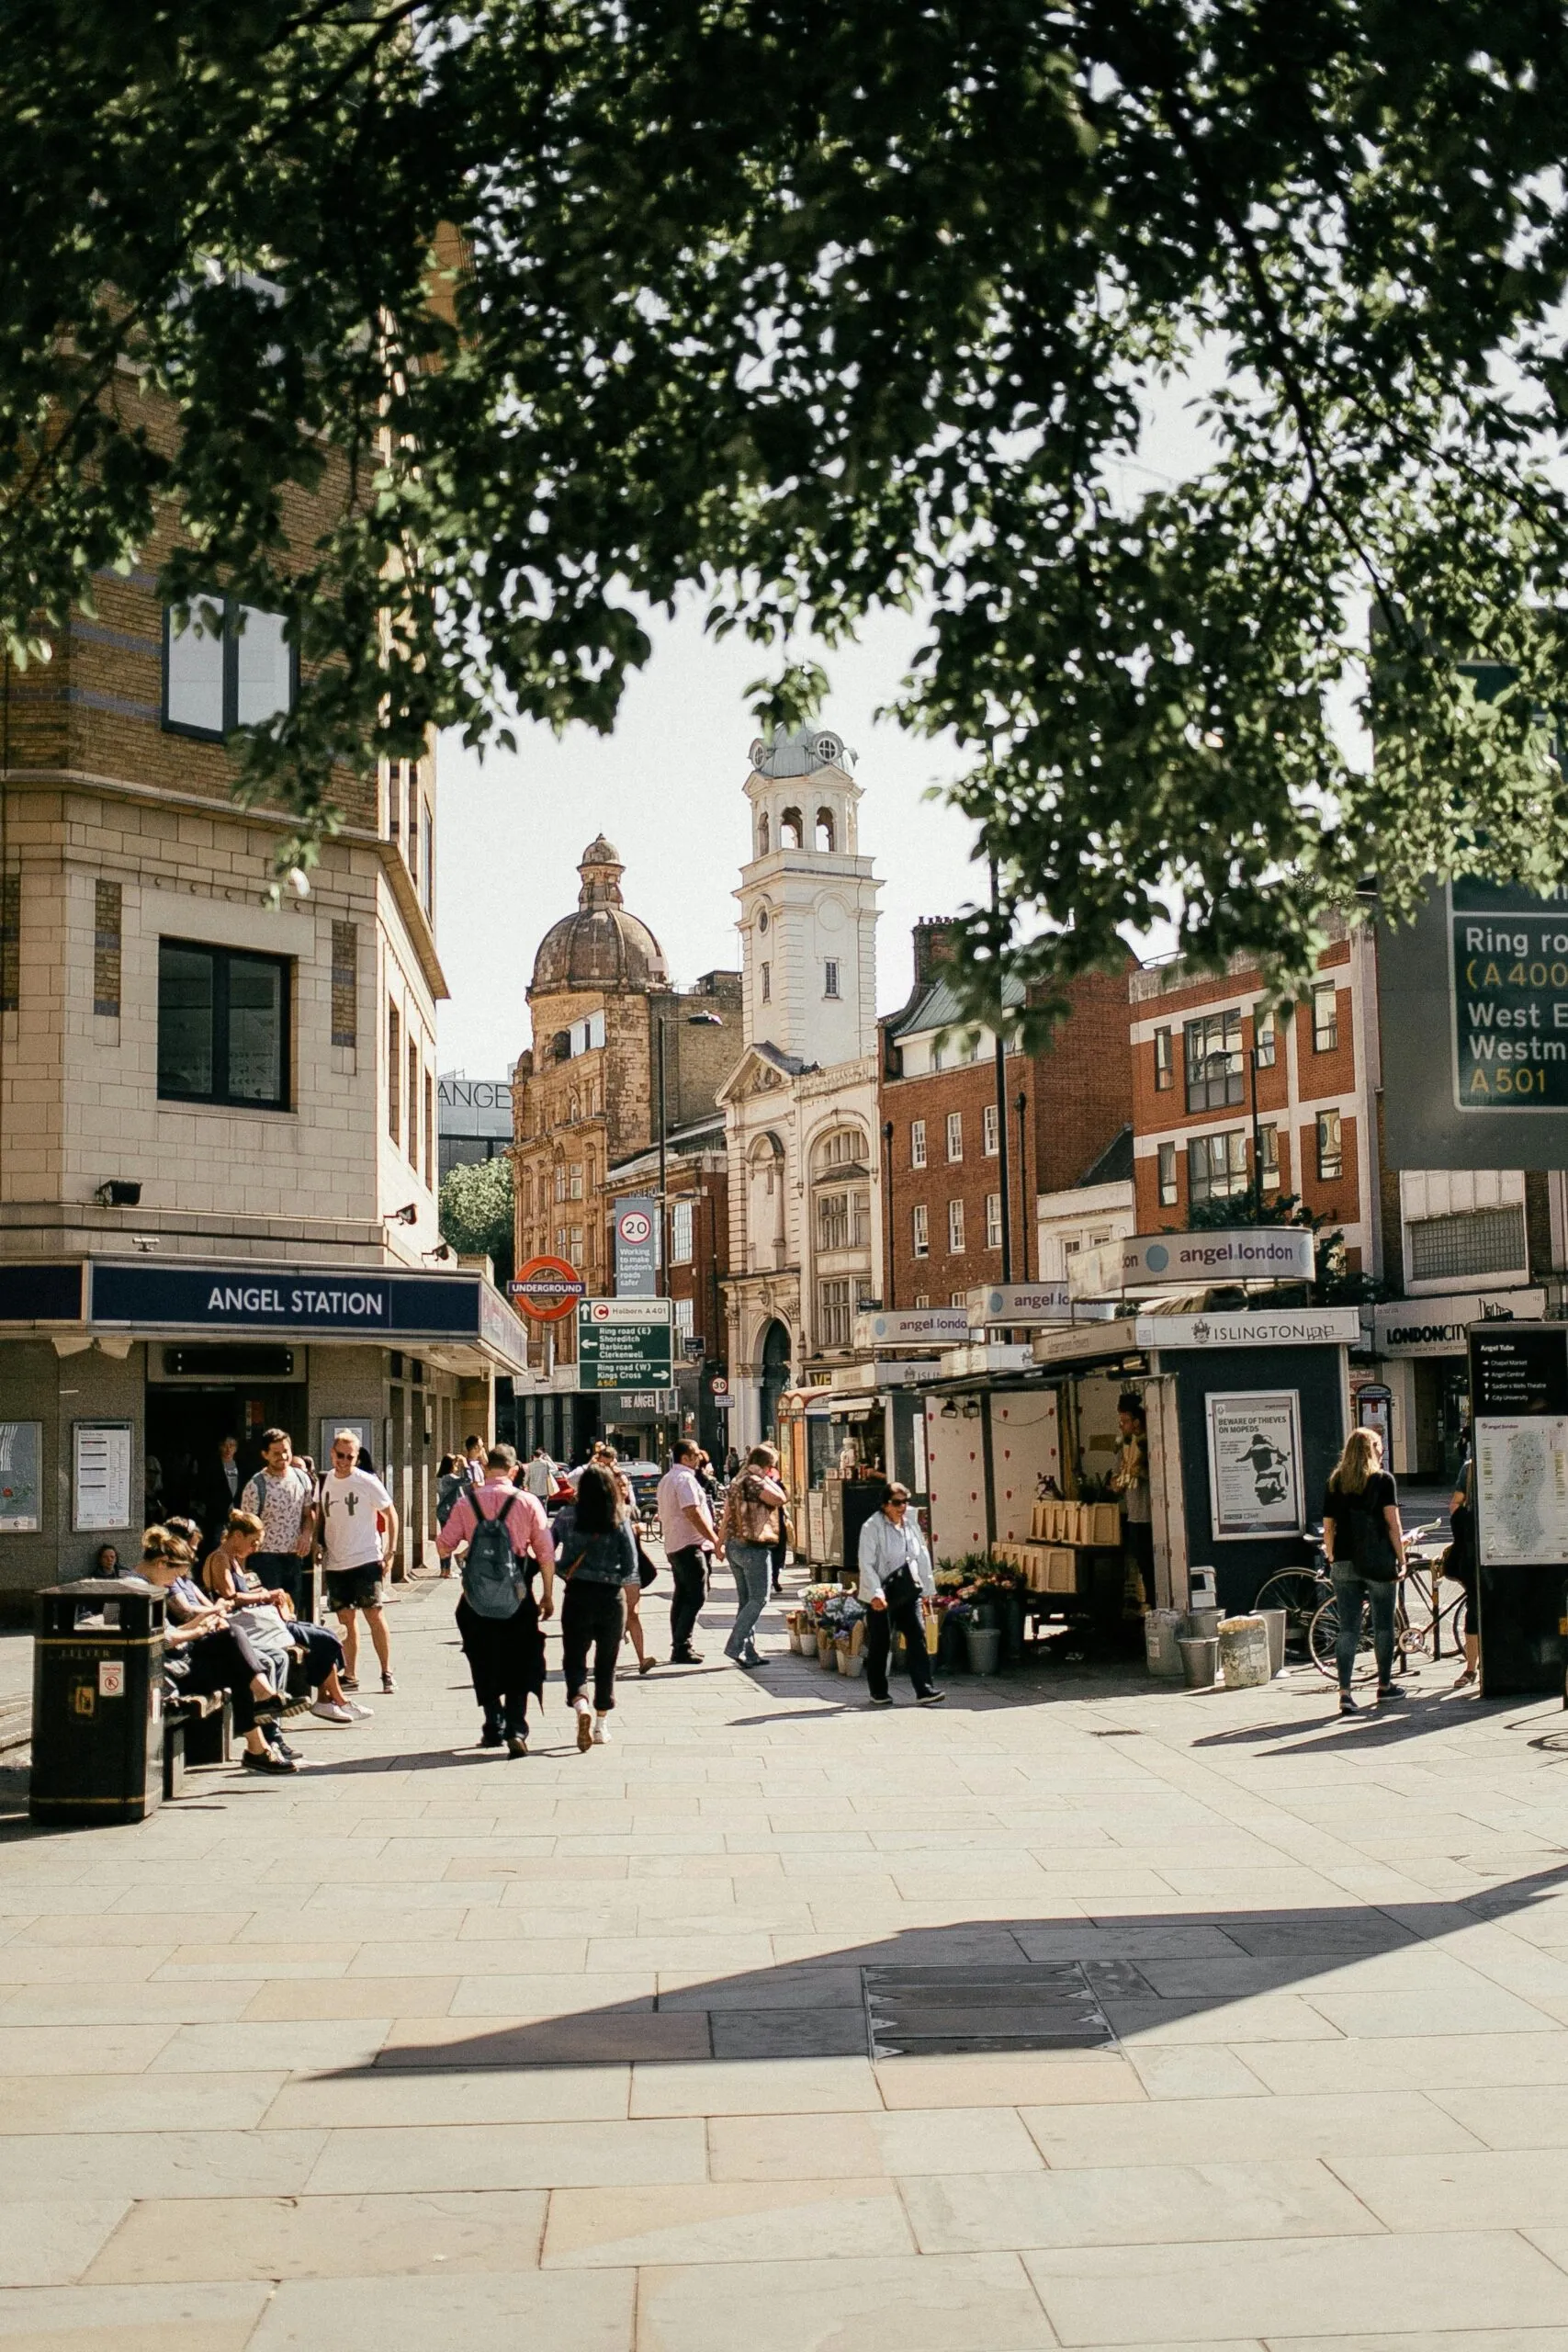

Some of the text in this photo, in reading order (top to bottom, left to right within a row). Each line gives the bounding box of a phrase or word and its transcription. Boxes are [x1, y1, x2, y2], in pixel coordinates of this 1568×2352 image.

[1466, 927, 1529, 957] Ring
[1468, 1002, 1540, 1028] West
[1470, 1035, 1565, 1060] Westm
[1471, 1068, 1545, 1092] A501
[626, 1221, 647, 1234] 20
[620, 1249, 650, 1257] Working
[512, 1283, 582, 1293] UNDERGROUND
[208, 1287, 382, 1315] ANGEL STATION
[599, 1328, 616, 1336] Ring
[637, 1327, 651, 1335] (E)
[1214, 1325, 1304, 1340] ISLINGTON
[635, 1363, 651, 1372] (W)
[597, 1372, 617, 1380] Kings
[620, 1396, 655, 1408] THE ANGEL
[1218, 1418, 1247, 1426] BEWARE
[1230, 1425, 1258, 1433] MOPEDS
